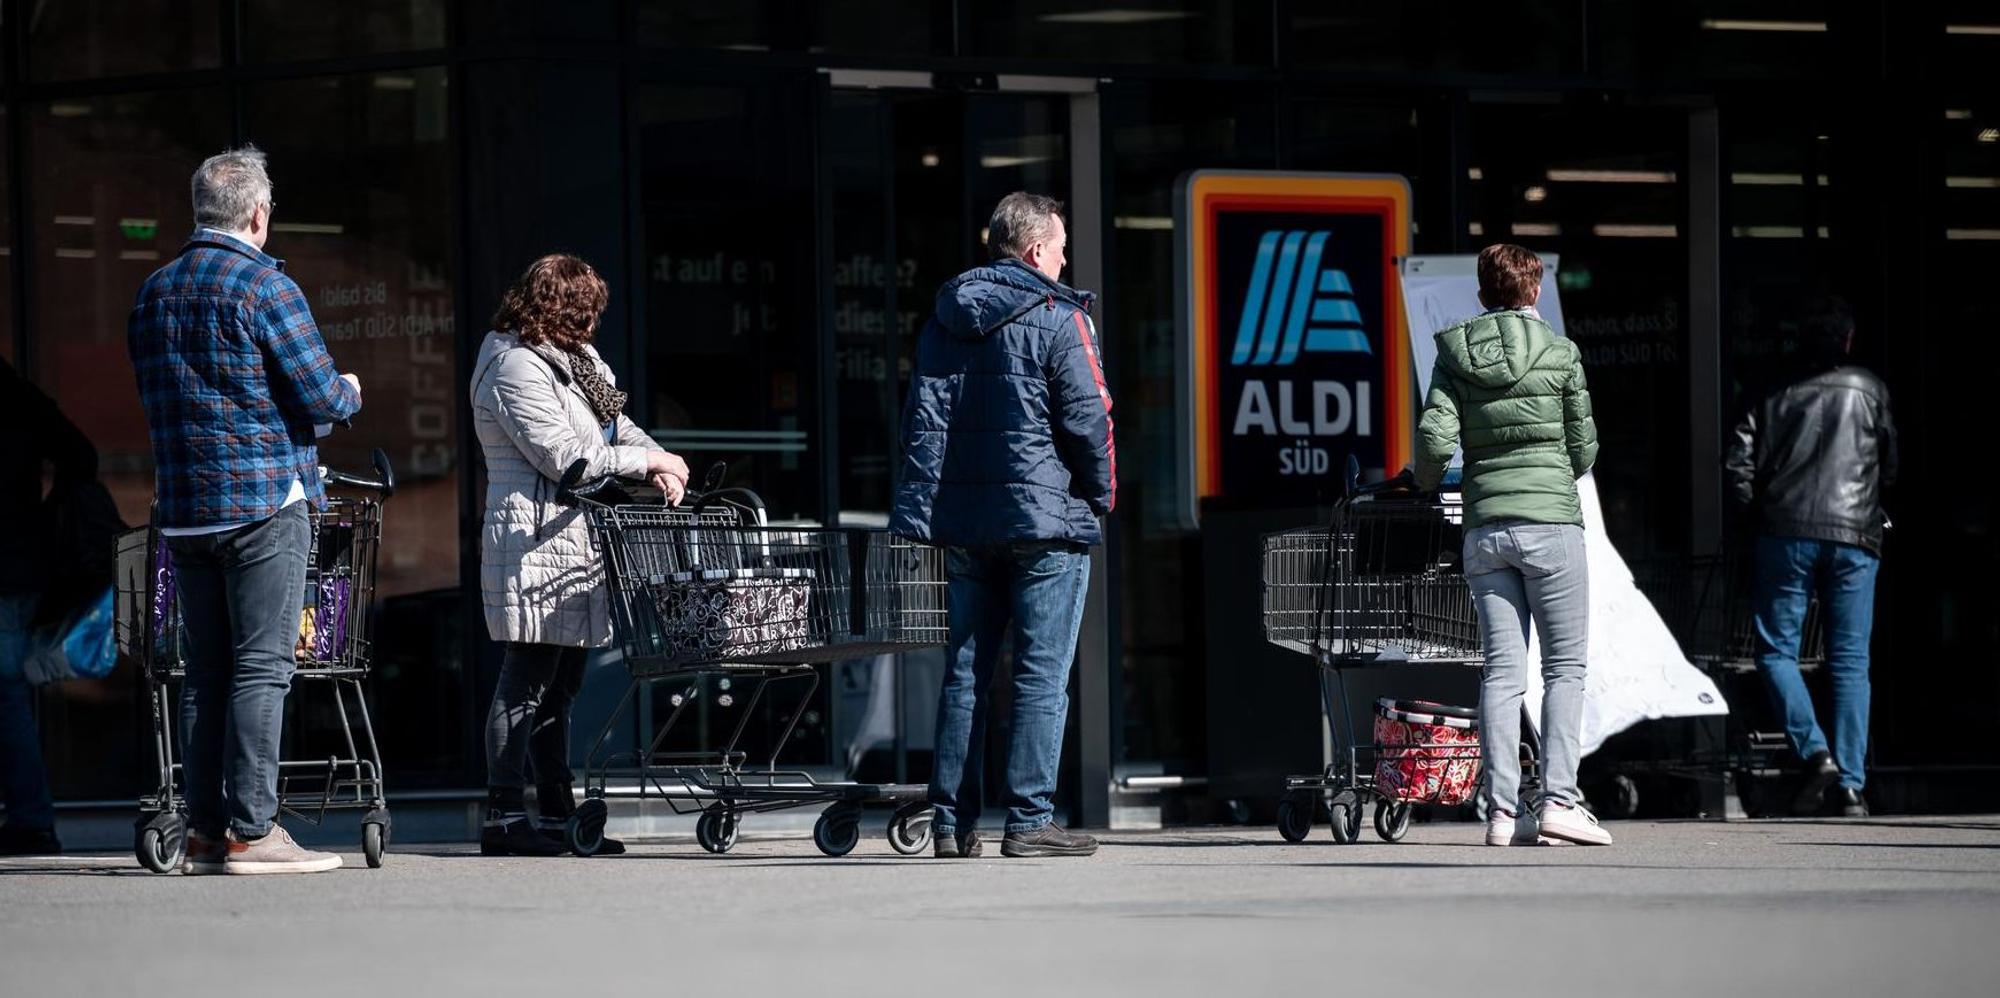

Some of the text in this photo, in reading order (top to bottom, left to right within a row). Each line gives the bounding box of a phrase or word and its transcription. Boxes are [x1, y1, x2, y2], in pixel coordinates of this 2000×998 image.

[679, 252, 723, 284] auf
[731, 258, 776, 286] en
[834, 254, 918, 287] affe?
[409, 260, 449, 475] COFFEE
[834, 346, 911, 382] Filiae
[1233, 380, 1371, 436] ALDI
[1279, 439, 1329, 475] SÜD
